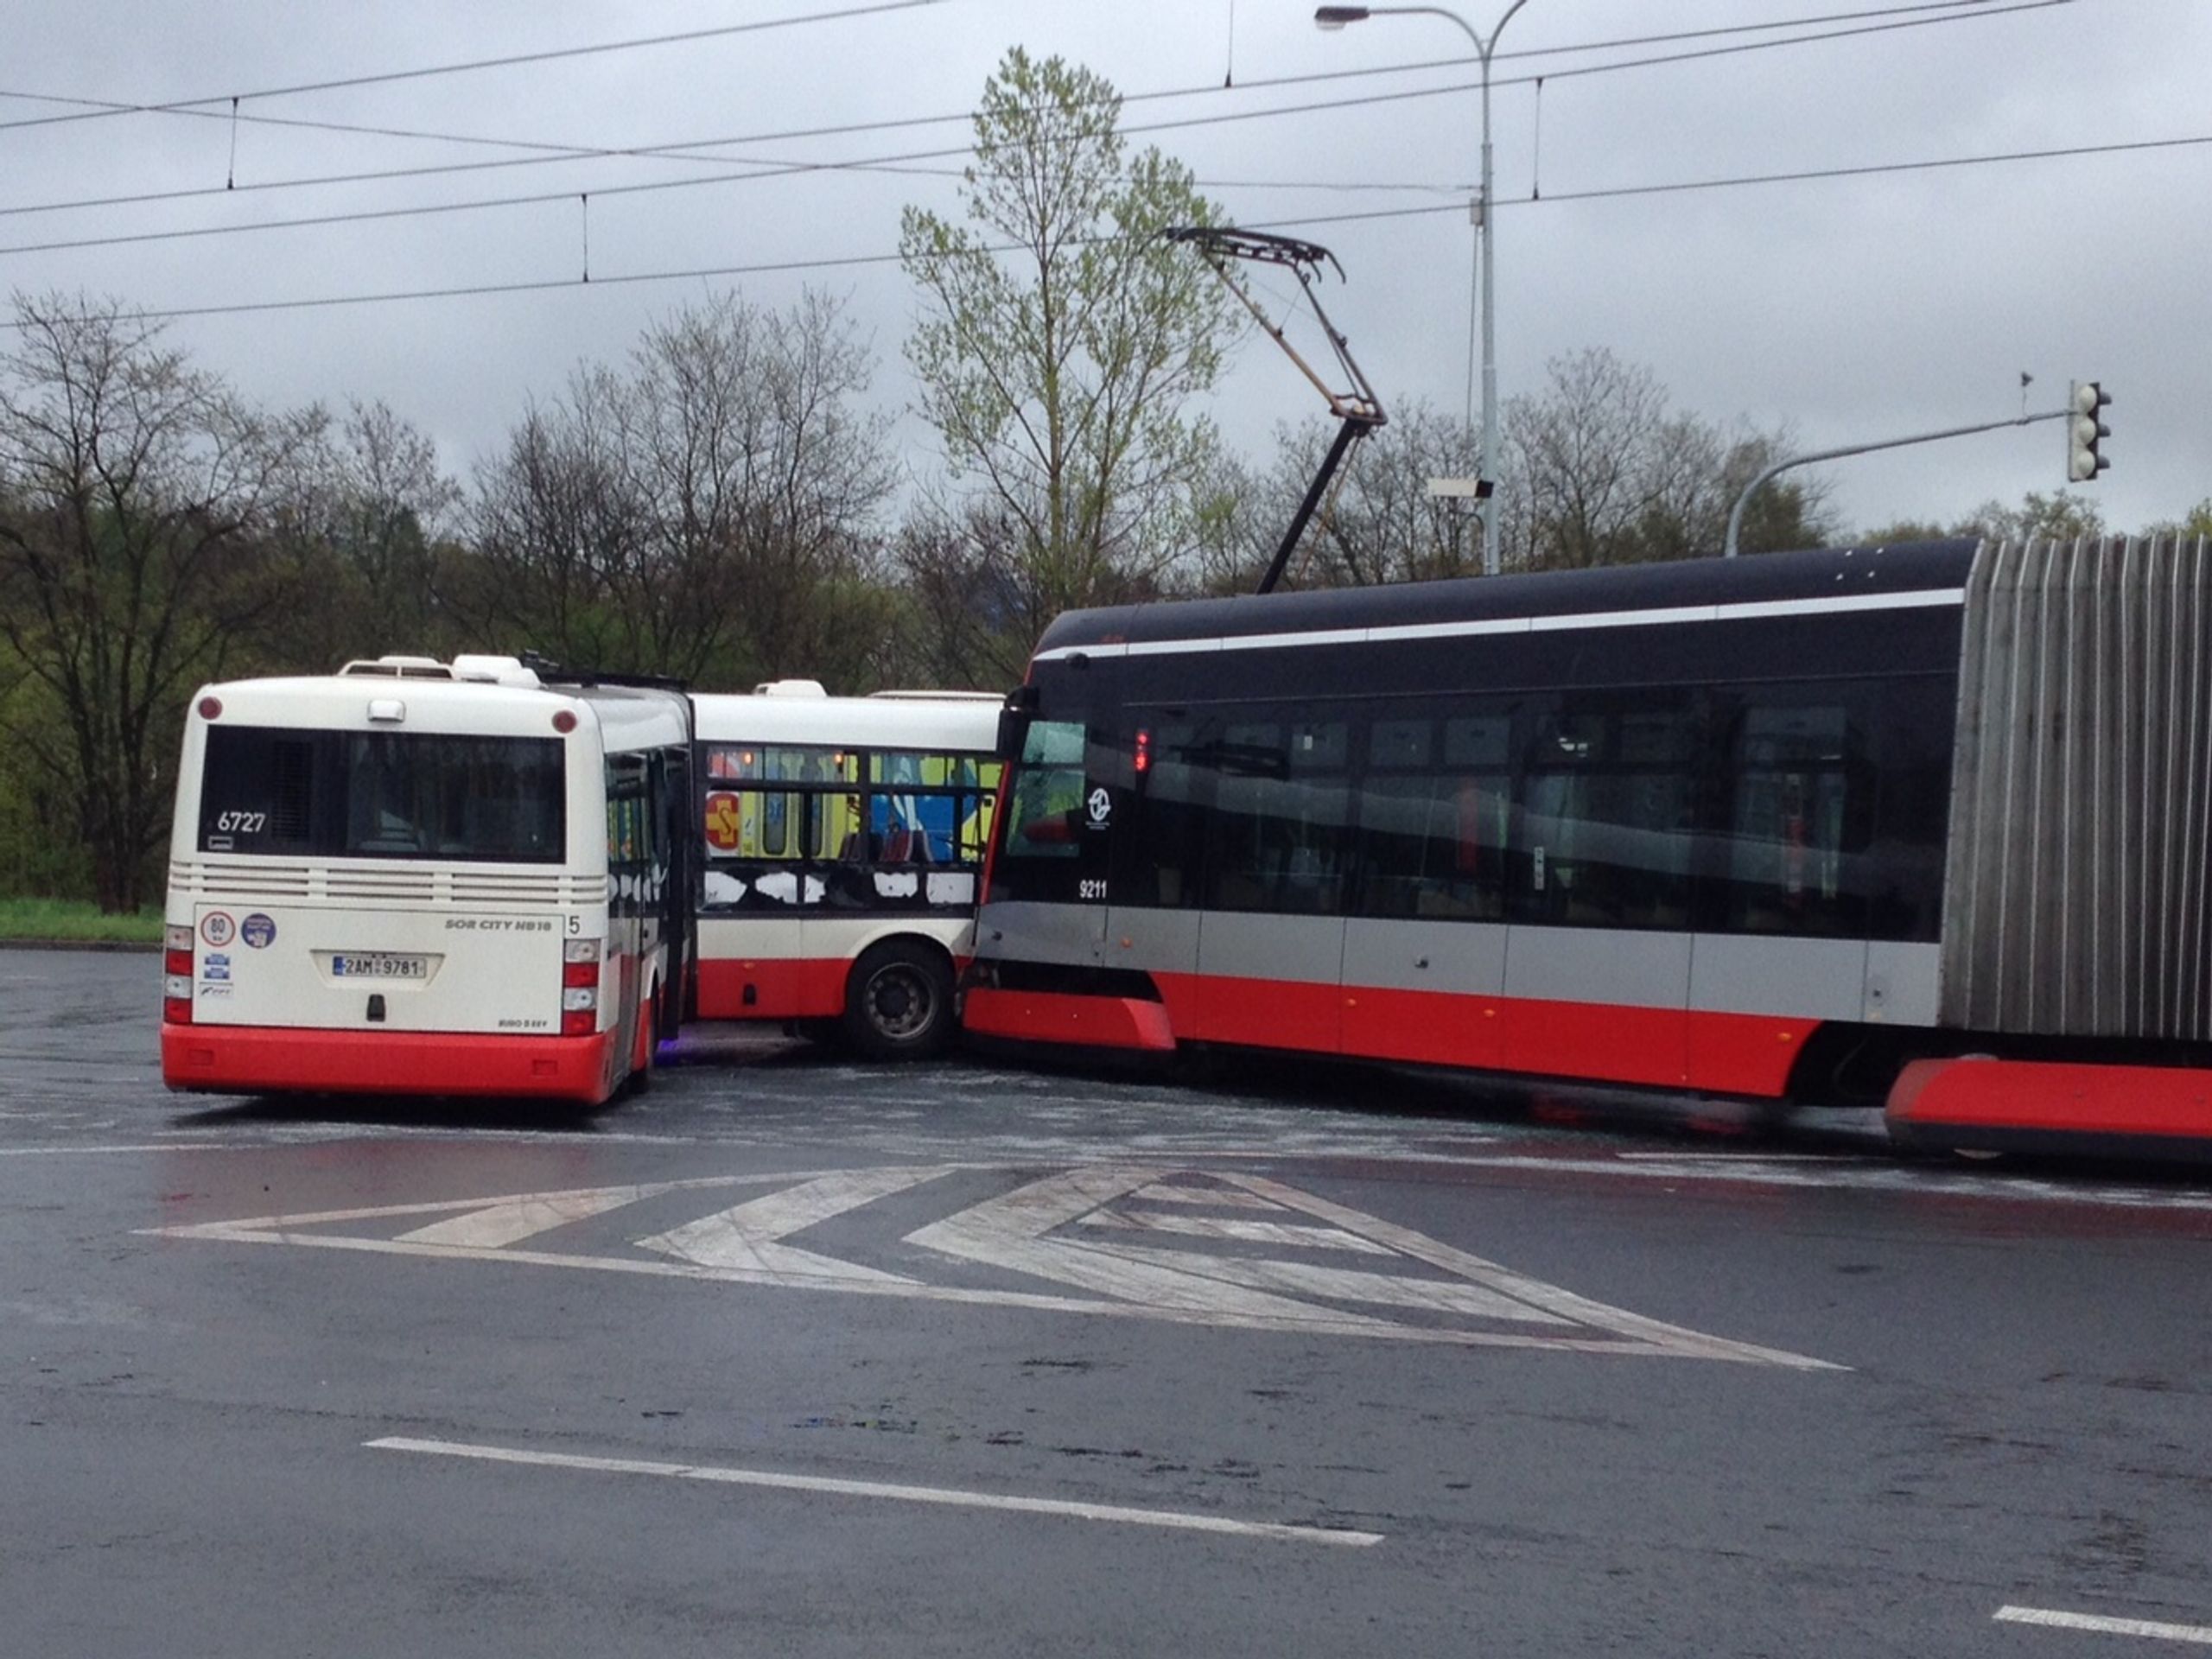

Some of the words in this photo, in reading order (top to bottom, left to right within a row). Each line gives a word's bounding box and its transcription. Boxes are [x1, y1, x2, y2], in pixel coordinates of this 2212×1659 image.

[218, 810, 266, 833] 6727
[1080, 880, 1107, 899] 9211
[211, 918, 226, 933] 80
[444, 919, 476, 930] SOR
[479, 920, 513, 931] CITY
[569, 915, 581, 935] 5
[346, 958, 372, 975] 2AM
[384, 960, 418, 976] 9781
